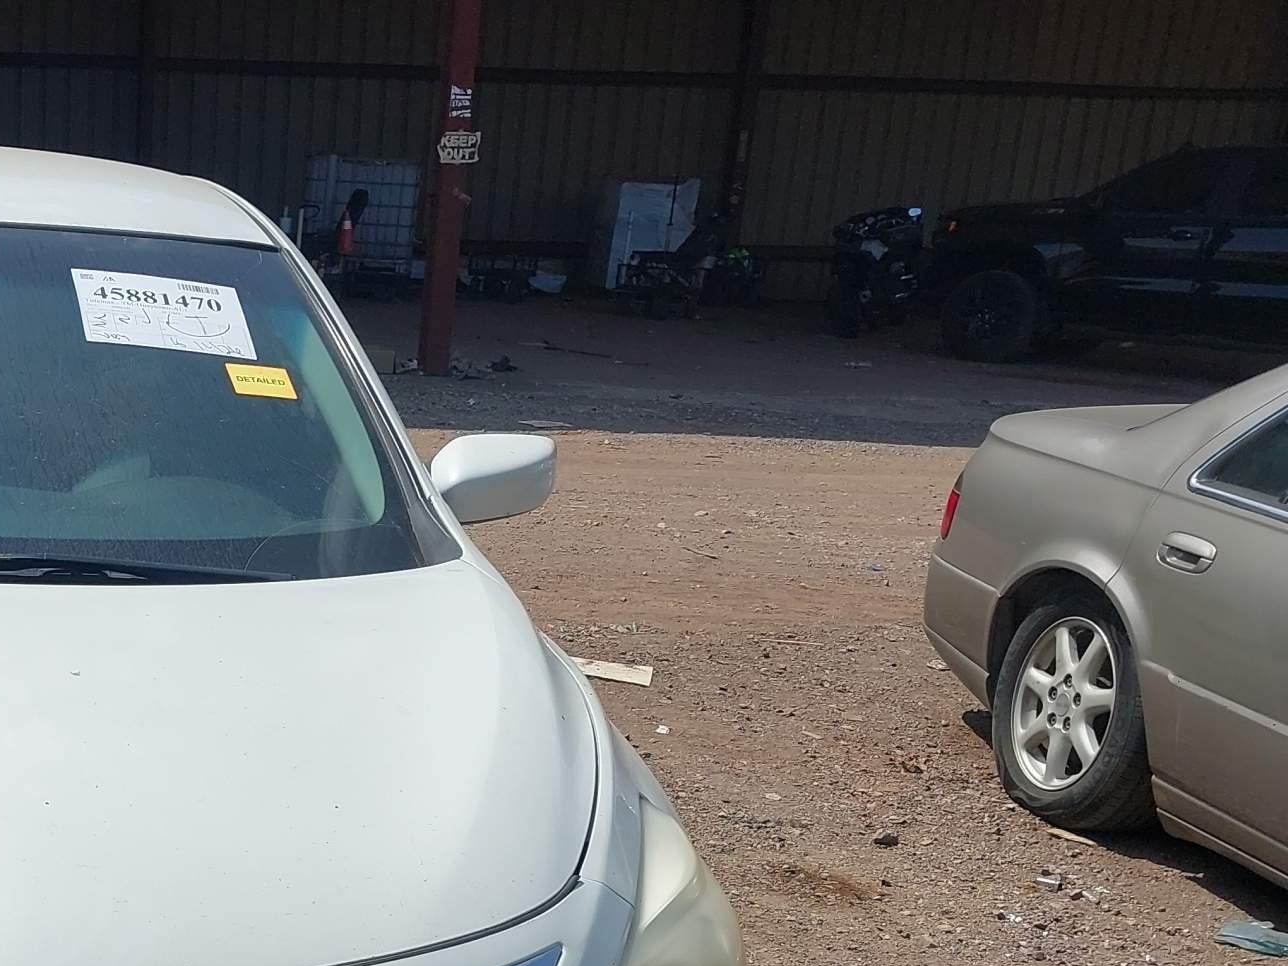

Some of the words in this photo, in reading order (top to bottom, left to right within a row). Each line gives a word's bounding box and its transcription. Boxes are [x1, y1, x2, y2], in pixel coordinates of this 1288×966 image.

[440, 135, 477, 147] KEEP
[445, 148, 476, 160] OUT
[93, 286, 223, 312] 45881470
[235, 375, 286, 386] DETAILED
